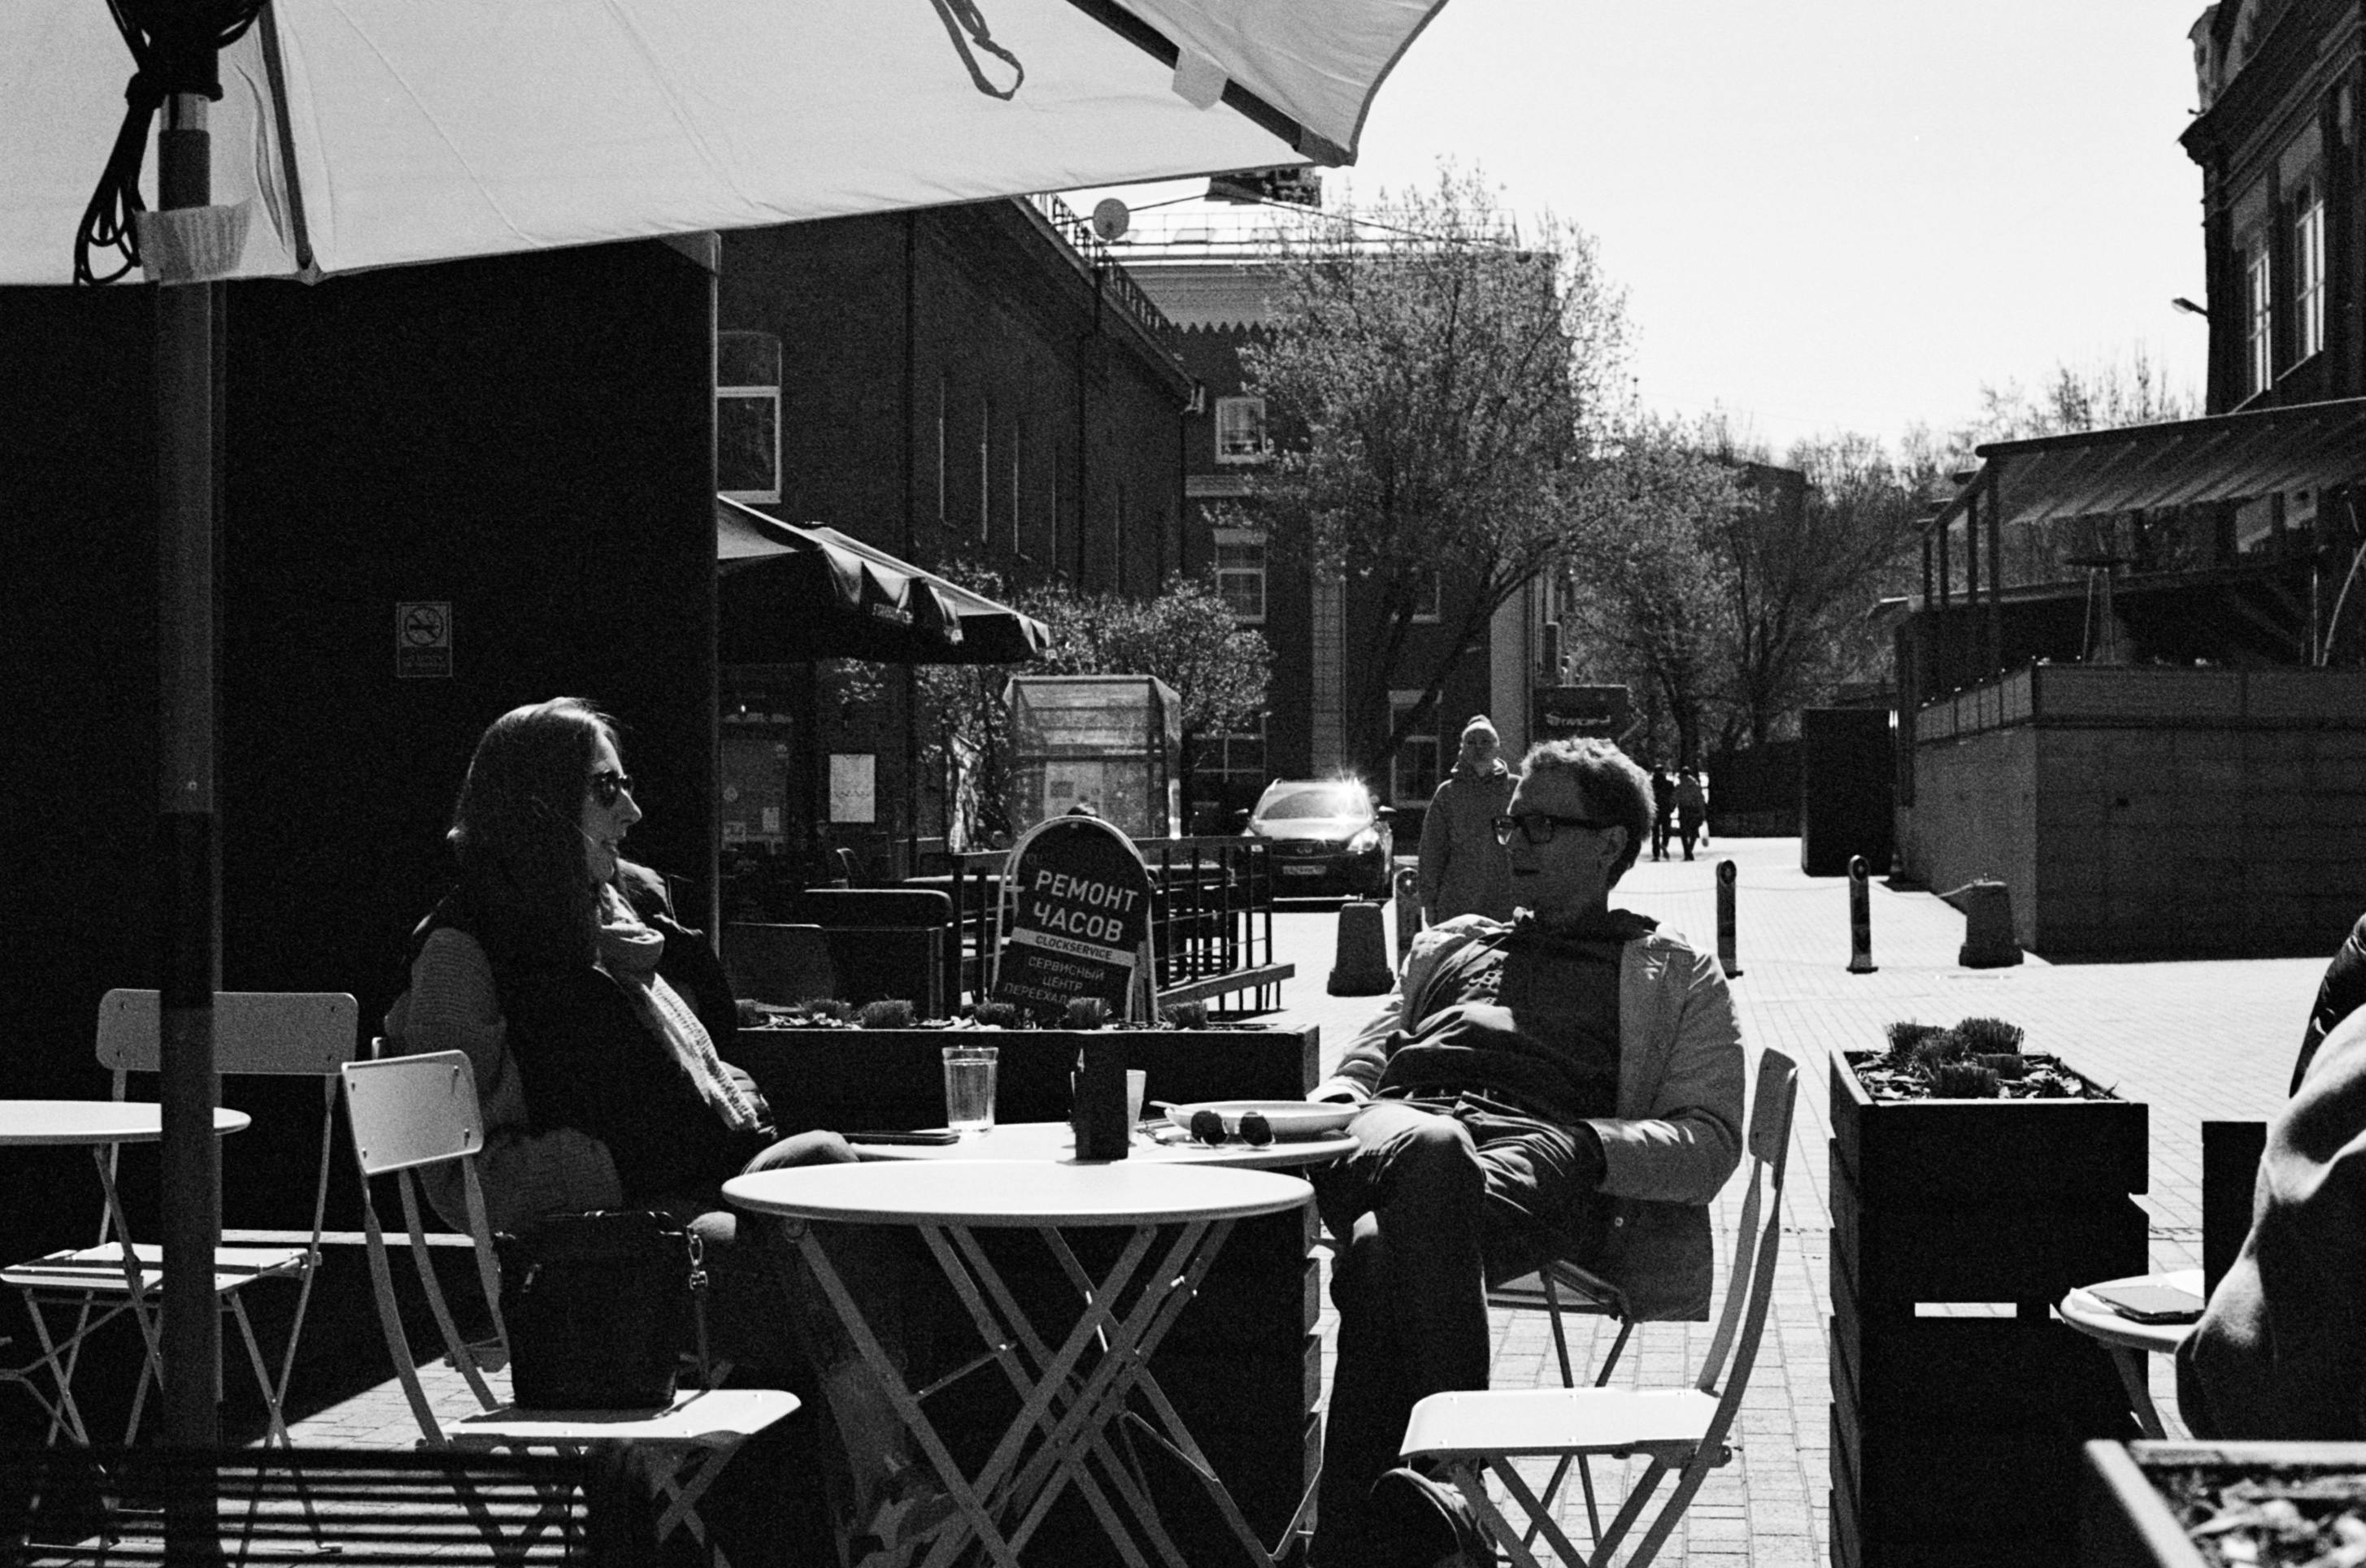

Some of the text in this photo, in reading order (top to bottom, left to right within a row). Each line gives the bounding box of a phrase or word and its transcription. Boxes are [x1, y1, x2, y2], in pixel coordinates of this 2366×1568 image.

[1035, 870, 1138, 912] РЕМОНТ
[1033, 901, 1124, 942] ЧАСОВ
[1035, 935, 1113, 960] CLOCKSERVICE
[1028, 956, 1105, 981] СЕРВИСНЫЙ
[1003, 982, 1068, 1004] ПЕРЕЕХАЛ
[1042, 975, 1084, 992] ЦЕНТР
